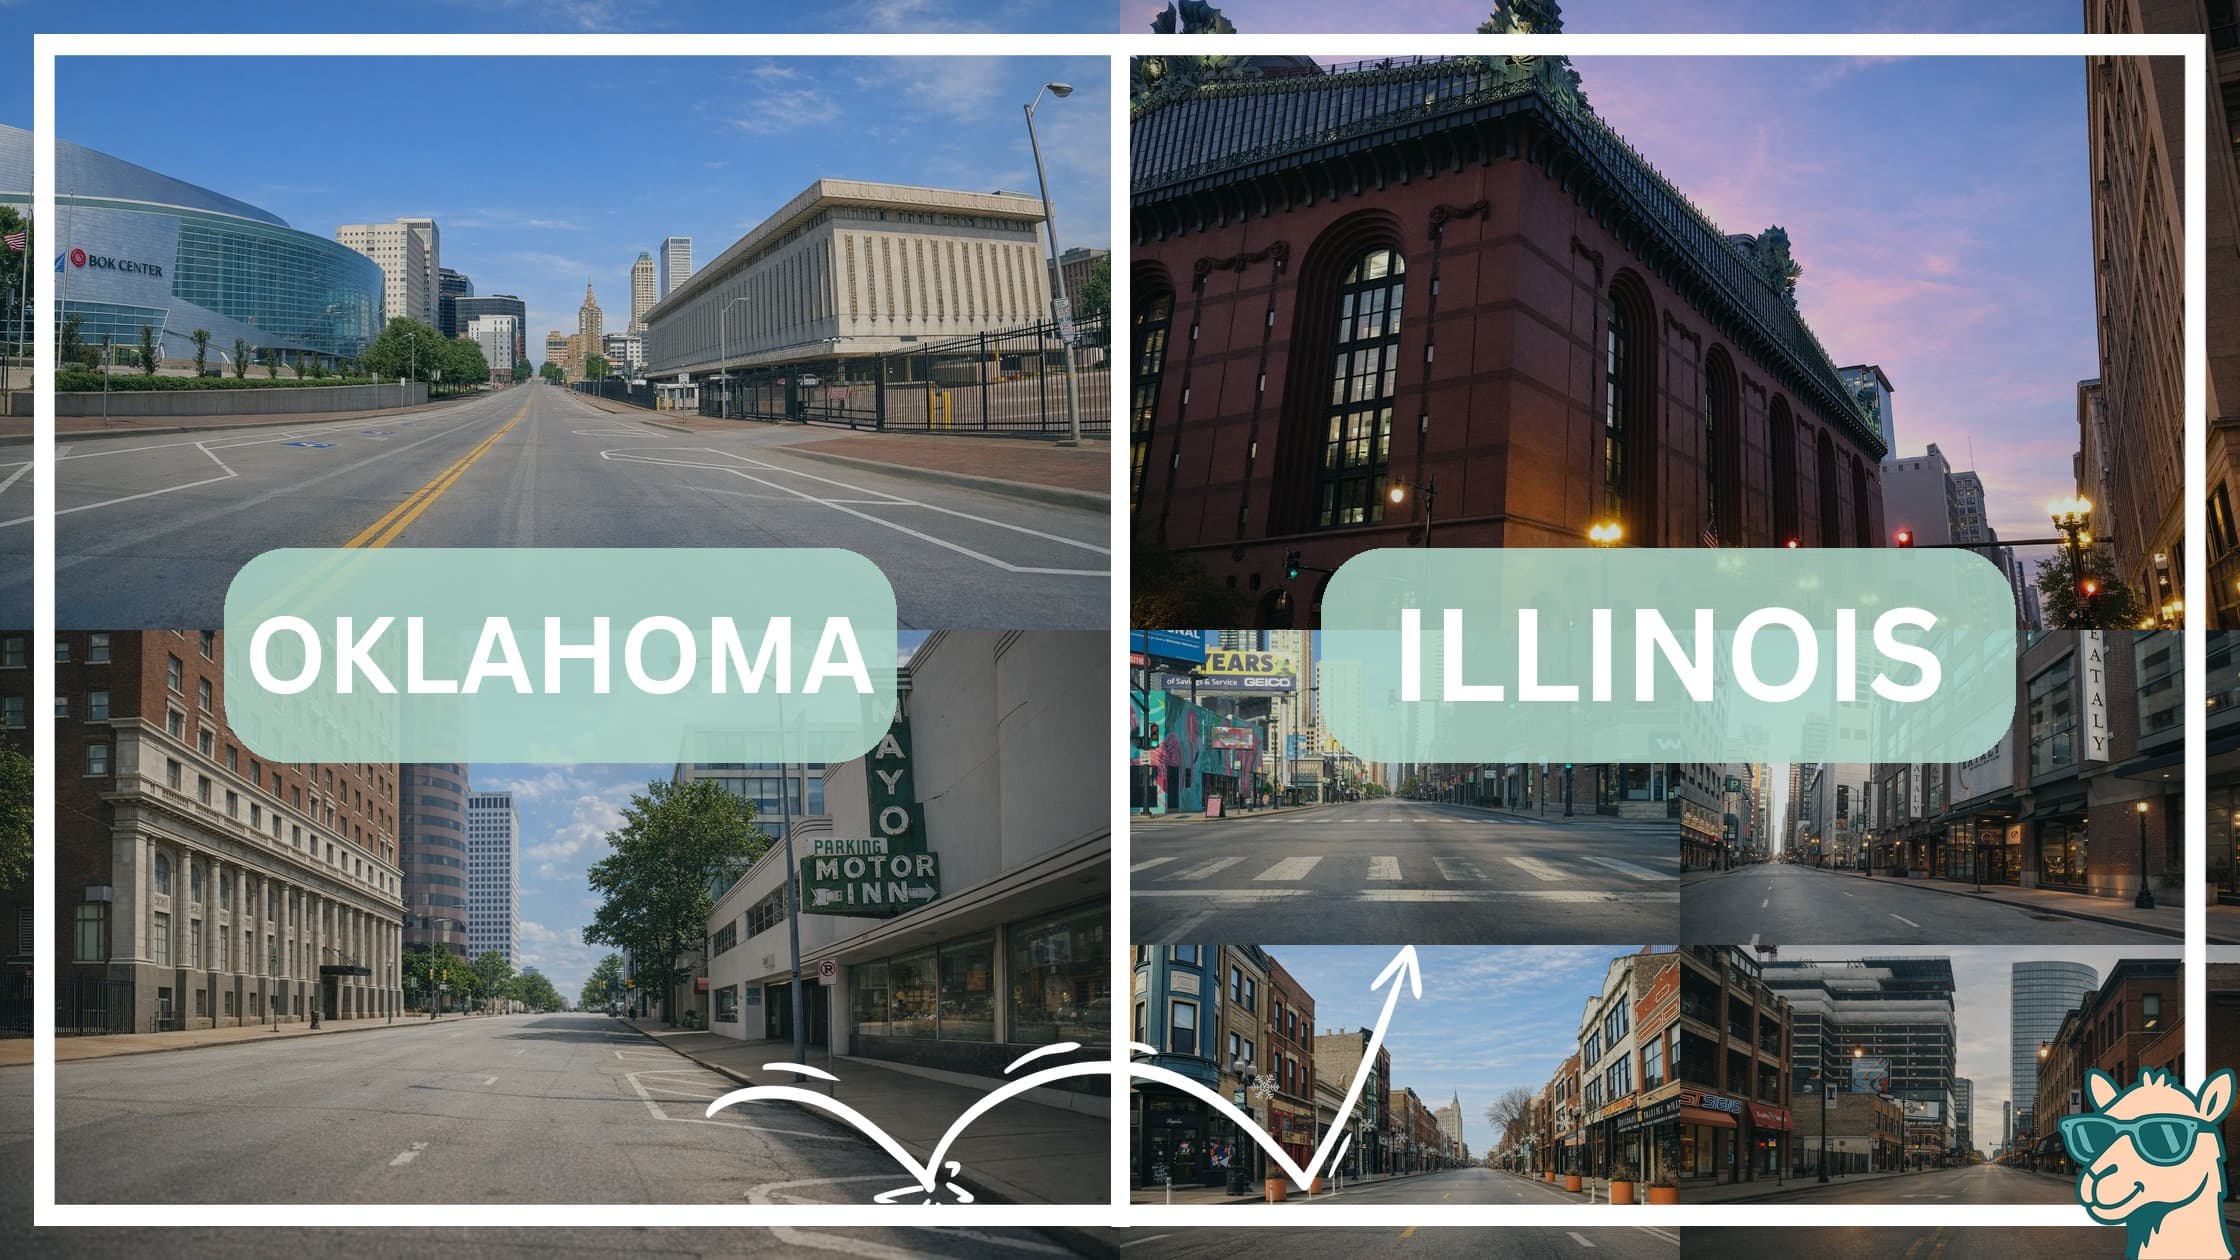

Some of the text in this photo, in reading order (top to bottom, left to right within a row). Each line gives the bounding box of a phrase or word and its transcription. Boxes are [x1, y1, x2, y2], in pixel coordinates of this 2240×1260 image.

[88, 254, 162, 277] BOK CENTER
[1176, 678, 1203, 686] Savigs
[1212, 678, 1238, 686] Service
[1244, 677, 1291, 687] GEICO
[1913, 763, 1921, 813] ATALY
[815, 839, 881, 854] PARKING
[816, 855, 935, 880] MOTOR
[847, 881, 908, 905] INN
[1704, 1093, 1742, 1114] SIGNS
